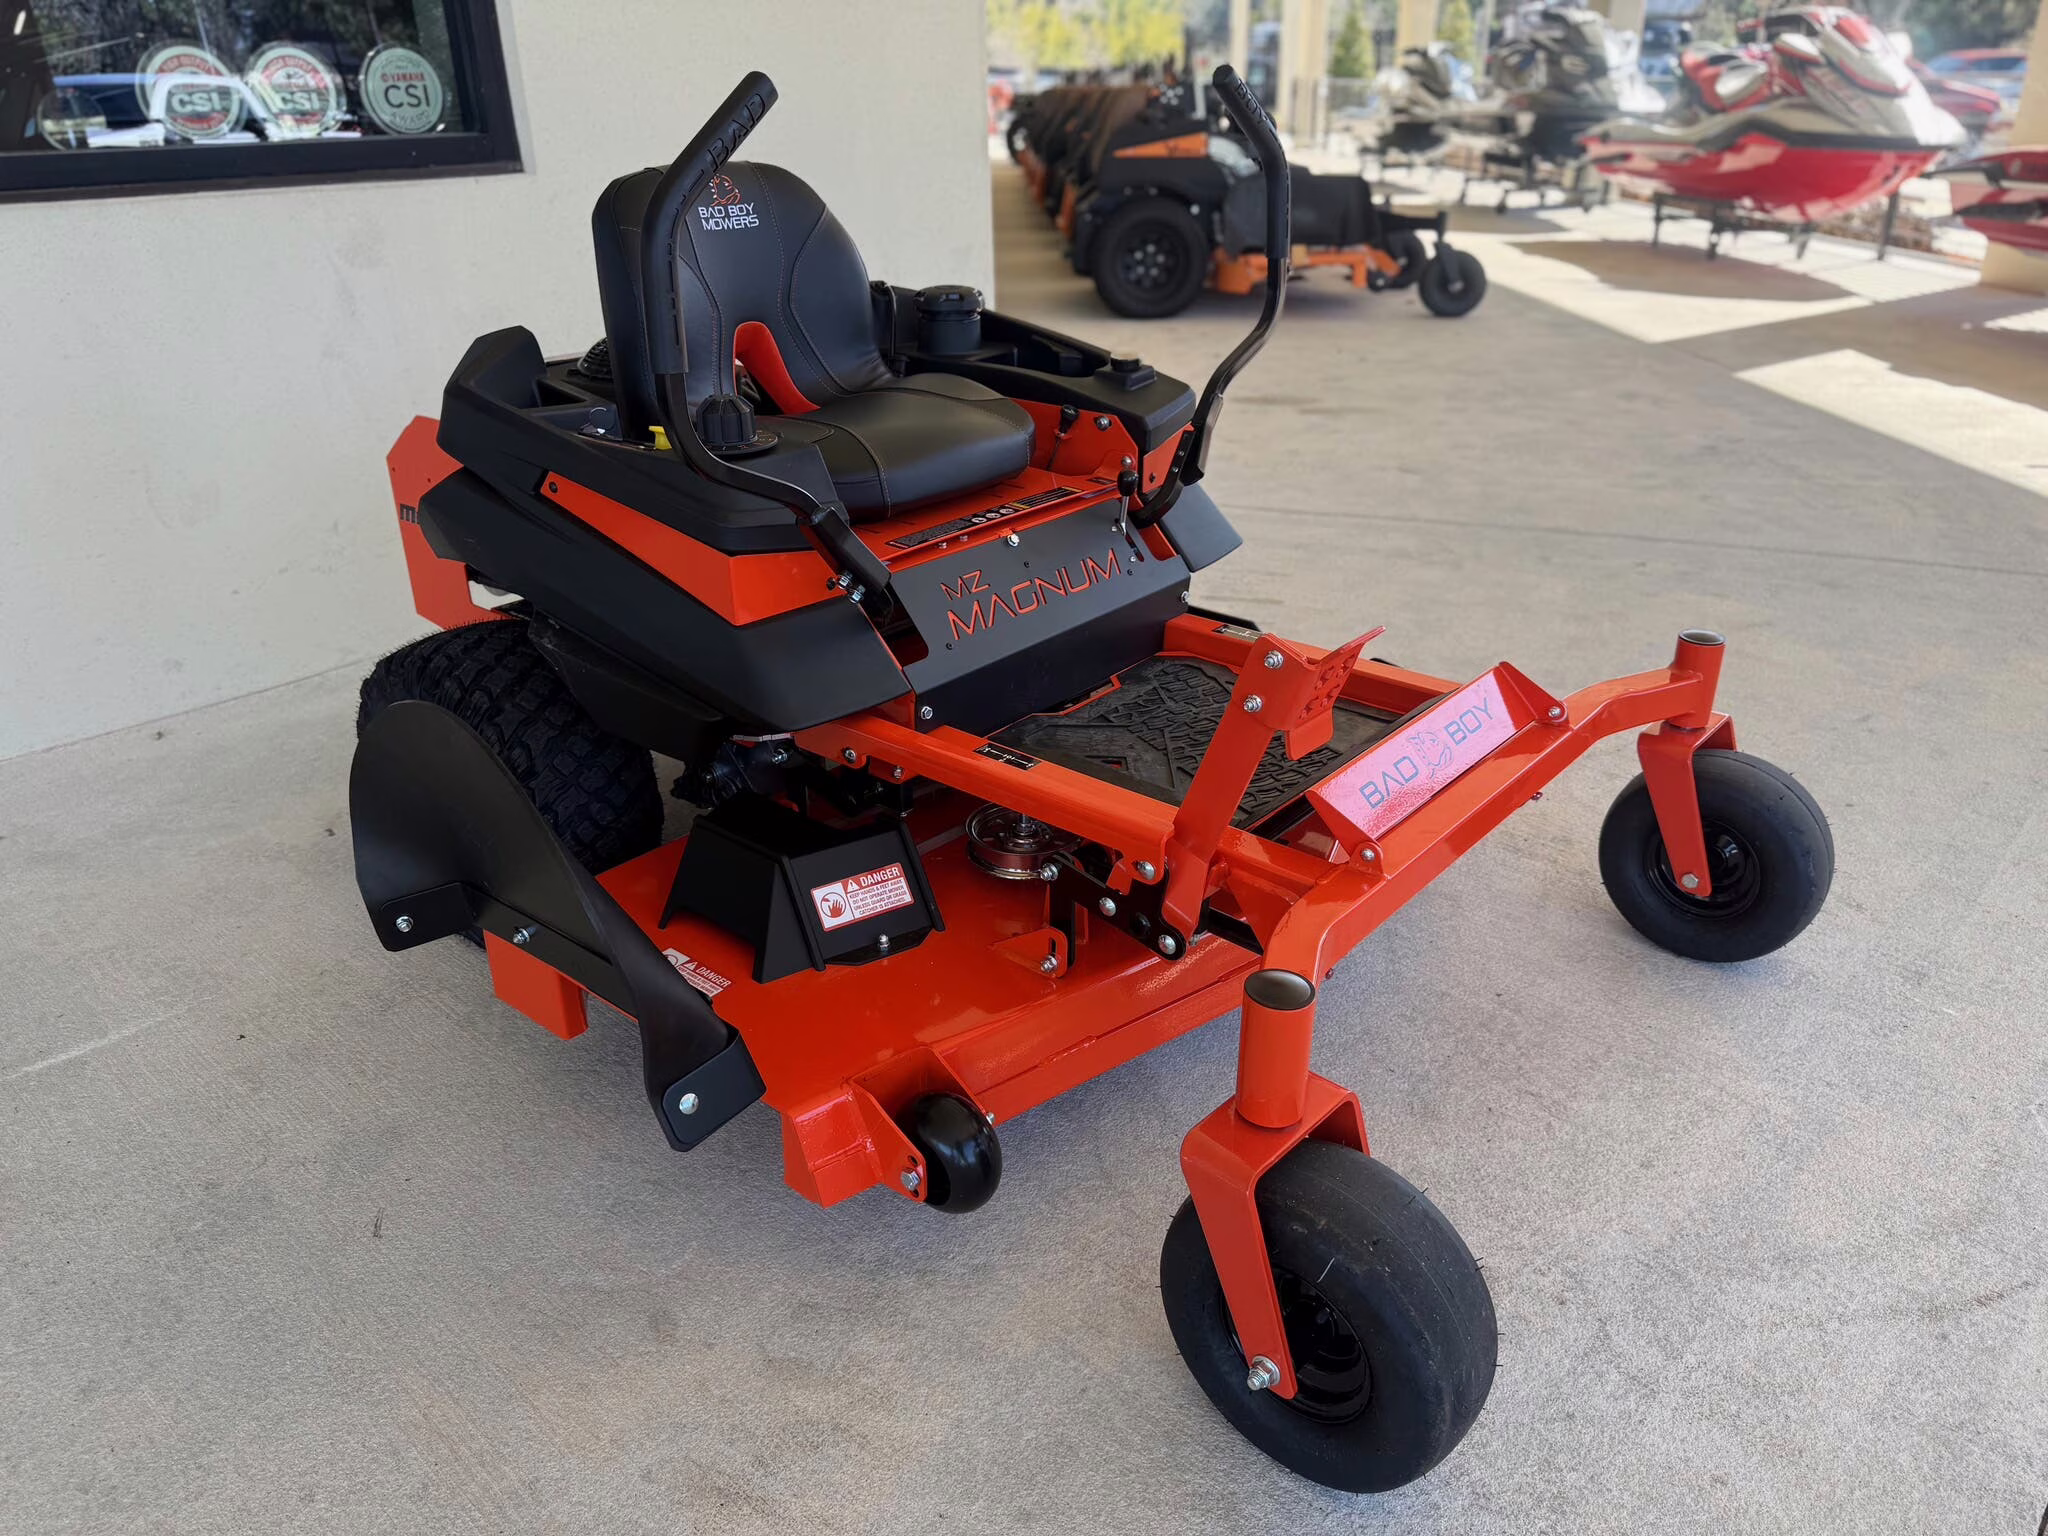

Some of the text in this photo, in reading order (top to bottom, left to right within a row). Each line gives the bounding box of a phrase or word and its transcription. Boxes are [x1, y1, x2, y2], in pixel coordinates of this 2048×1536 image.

[391, 72, 426, 82] YAMAHA
[171, 91, 222, 113] CSI
[277, 91, 320, 110] CSI
[384, 83, 430, 108] CSI
[698, 203, 755, 219] BAD BOY
[701, 214, 760, 231] MOWERS
[940, 569, 991, 601] MZ
[947, 547, 1122, 641] MAGNUM
[1359, 697, 1494, 810] BAD BOY
[860, 866, 900, 887] DANGER
[849, 891, 860, 899] KEEP
[861, 887, 876, 896] HANDS
[695, 966, 733, 988] DANGER
